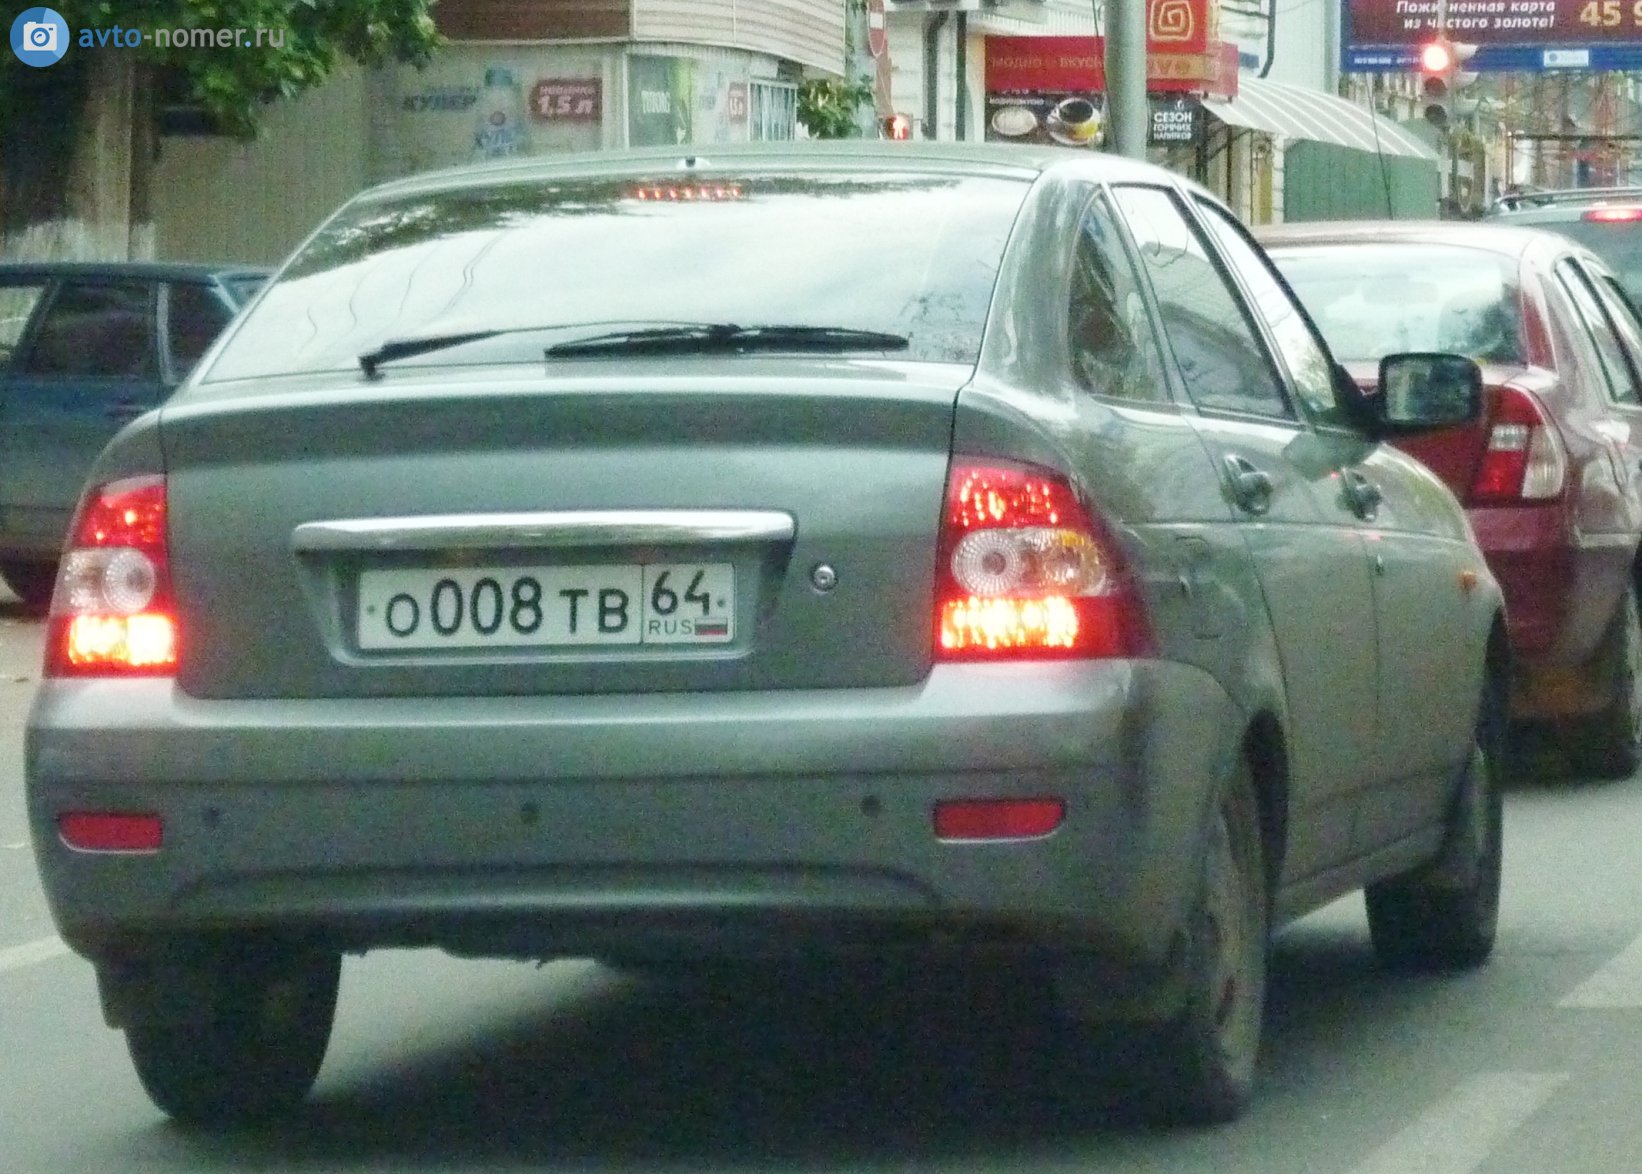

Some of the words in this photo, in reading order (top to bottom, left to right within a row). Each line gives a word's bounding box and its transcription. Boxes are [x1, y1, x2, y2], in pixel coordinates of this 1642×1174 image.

[1396, 1, 1505, 13] Пожиненная
[1511, 1, 1555, 14] карта
[1580, 1, 1621, 26] 45
[1403, 18, 1421, 29] из
[1427, 18, 1488, 29] чстого
[1494, 15, 1555, 29] золота!
[1153, 111, 1192, 122] СЕЗОН
[651, 570, 712, 615] 64
[648, 619, 693, 636] RUS
